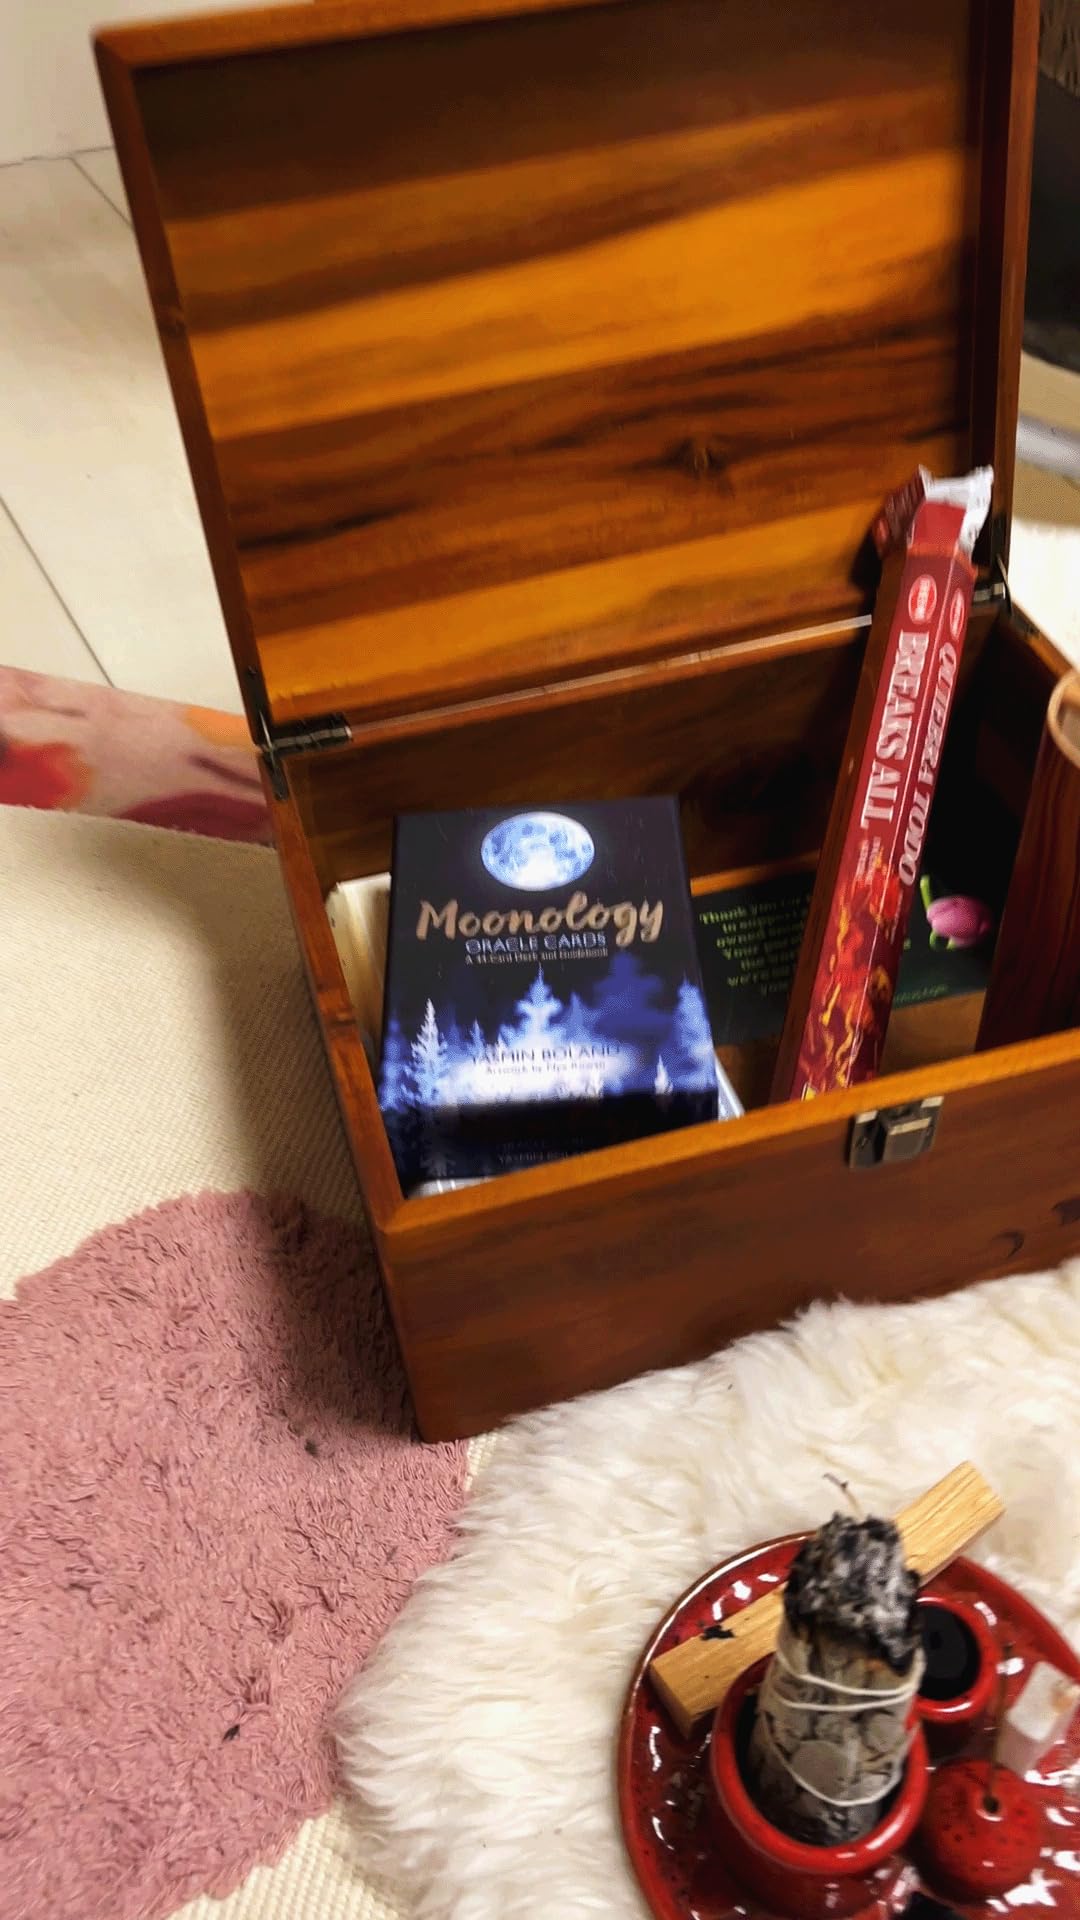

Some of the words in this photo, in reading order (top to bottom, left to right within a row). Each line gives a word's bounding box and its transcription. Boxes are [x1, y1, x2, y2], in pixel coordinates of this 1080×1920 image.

[876, 629, 929, 760] BREAKS
[860, 760, 900, 829] ALL
[899, 788, 930, 886] TODO
[416, 891, 663, 947] Moonology
[465, 935, 538, 954] ORACLE
[544, 931, 606, 950] CARDS
[699, 906, 746, 924] Thank
[471, 1048, 534, 1064] YASMIN
[542, 1045, 619, 1061] BOLAND
